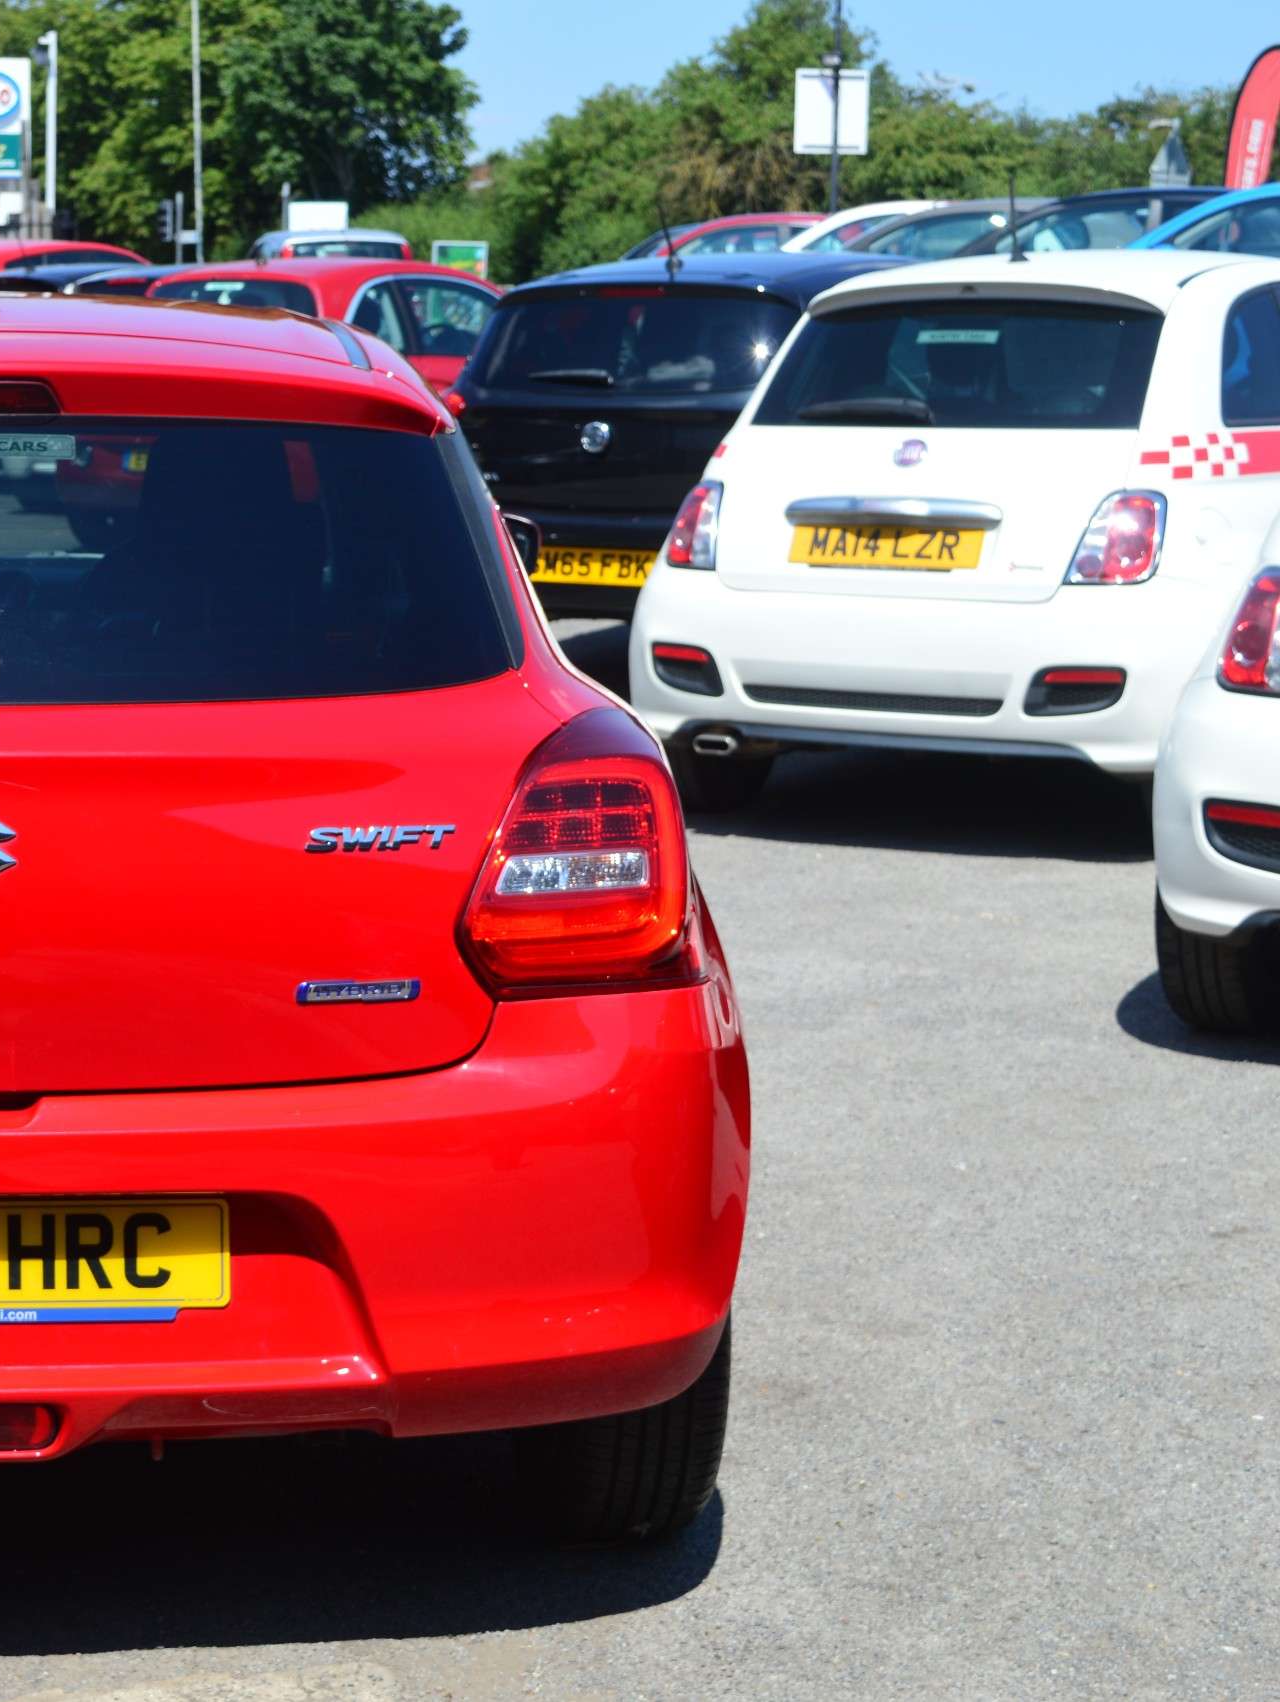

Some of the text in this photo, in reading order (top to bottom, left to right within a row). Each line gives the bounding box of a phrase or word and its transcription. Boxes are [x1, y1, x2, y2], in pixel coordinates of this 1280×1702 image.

[808, 527, 961, 561] MA14 LZR
[599, 554, 651, 579] FBK
[304, 823, 456, 854] SWIFT
[7, 1212, 172, 1290] HRC
